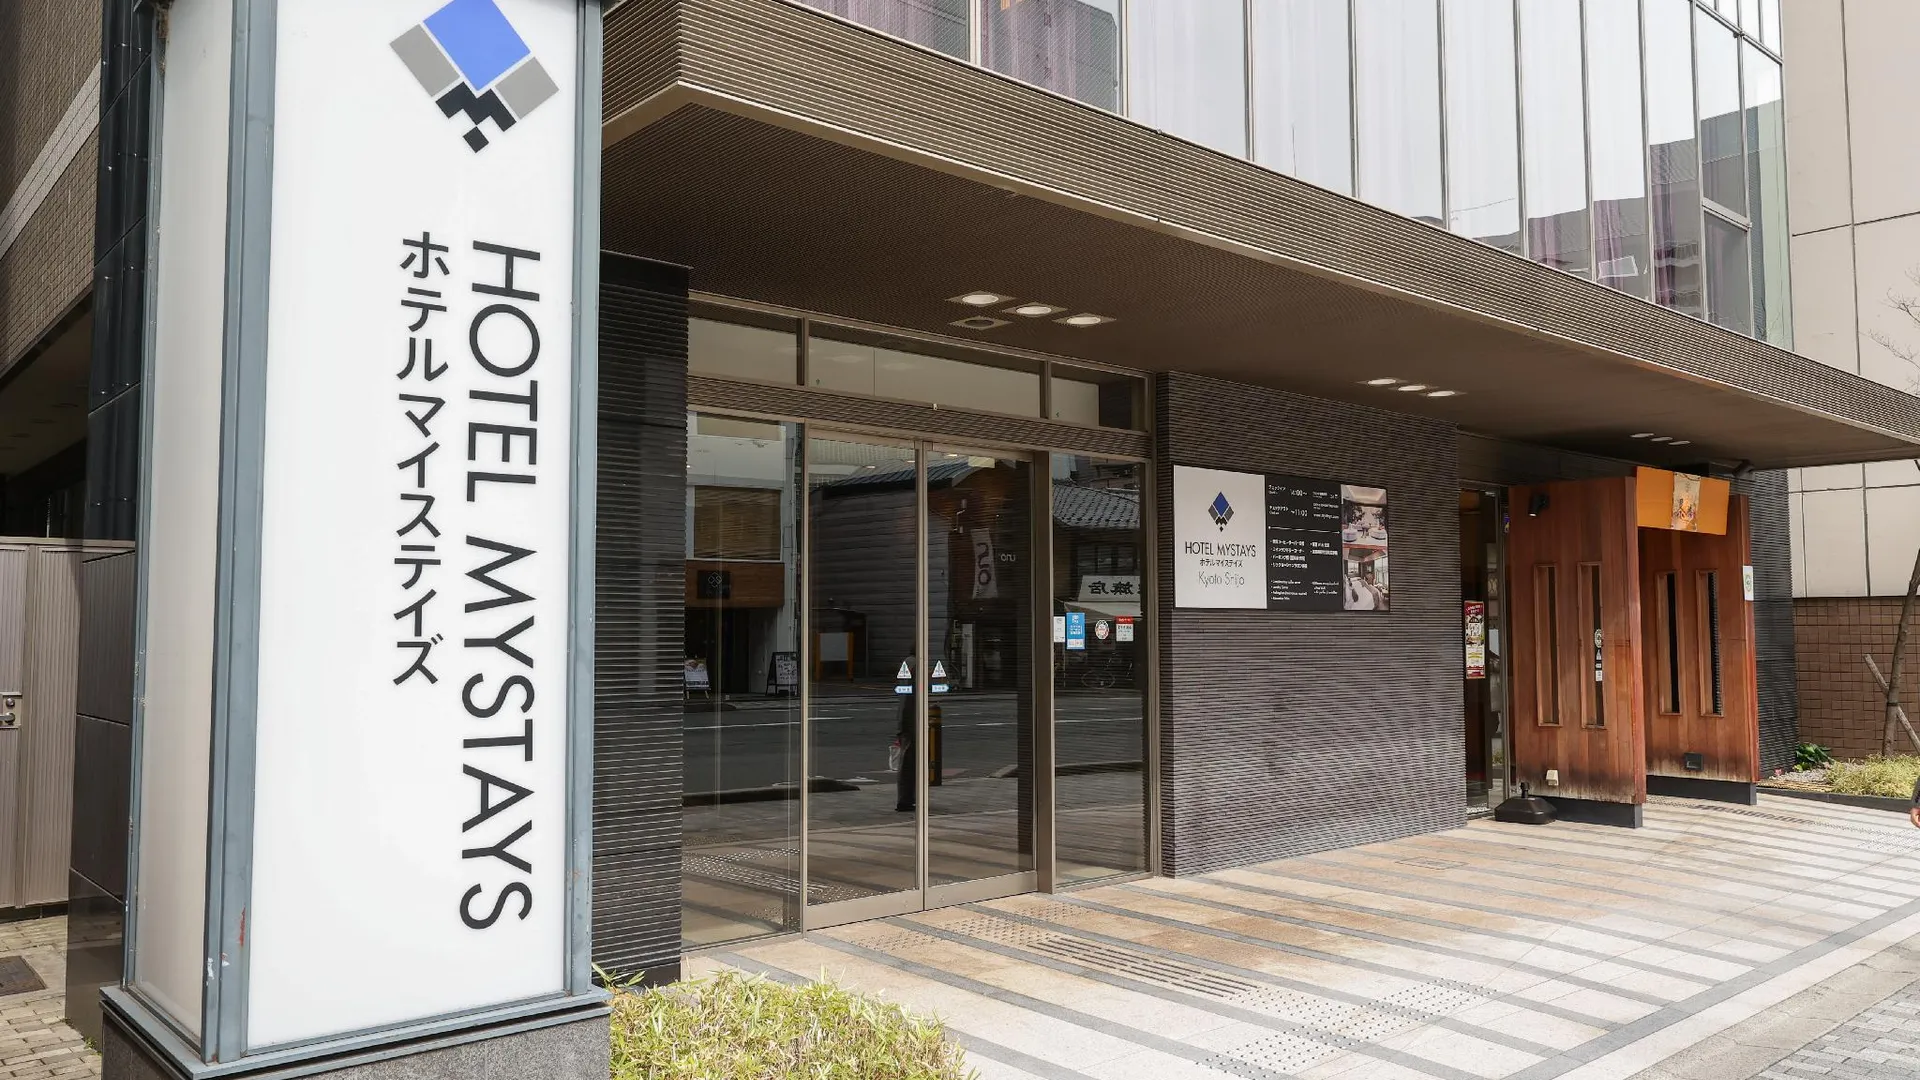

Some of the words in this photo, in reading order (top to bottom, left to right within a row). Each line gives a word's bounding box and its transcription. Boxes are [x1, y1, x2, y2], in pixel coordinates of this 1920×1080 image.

[393, 232, 450, 686] ホテルマイステイズ
[467, 240, 541, 503] HOTEL
[1184, 541, 1214, 556] HOTEL
[1216, 542, 1257, 558] MYSTAYS
[1198, 571, 1223, 588] Kyoto
[460, 535, 537, 930] MYSTAYS
